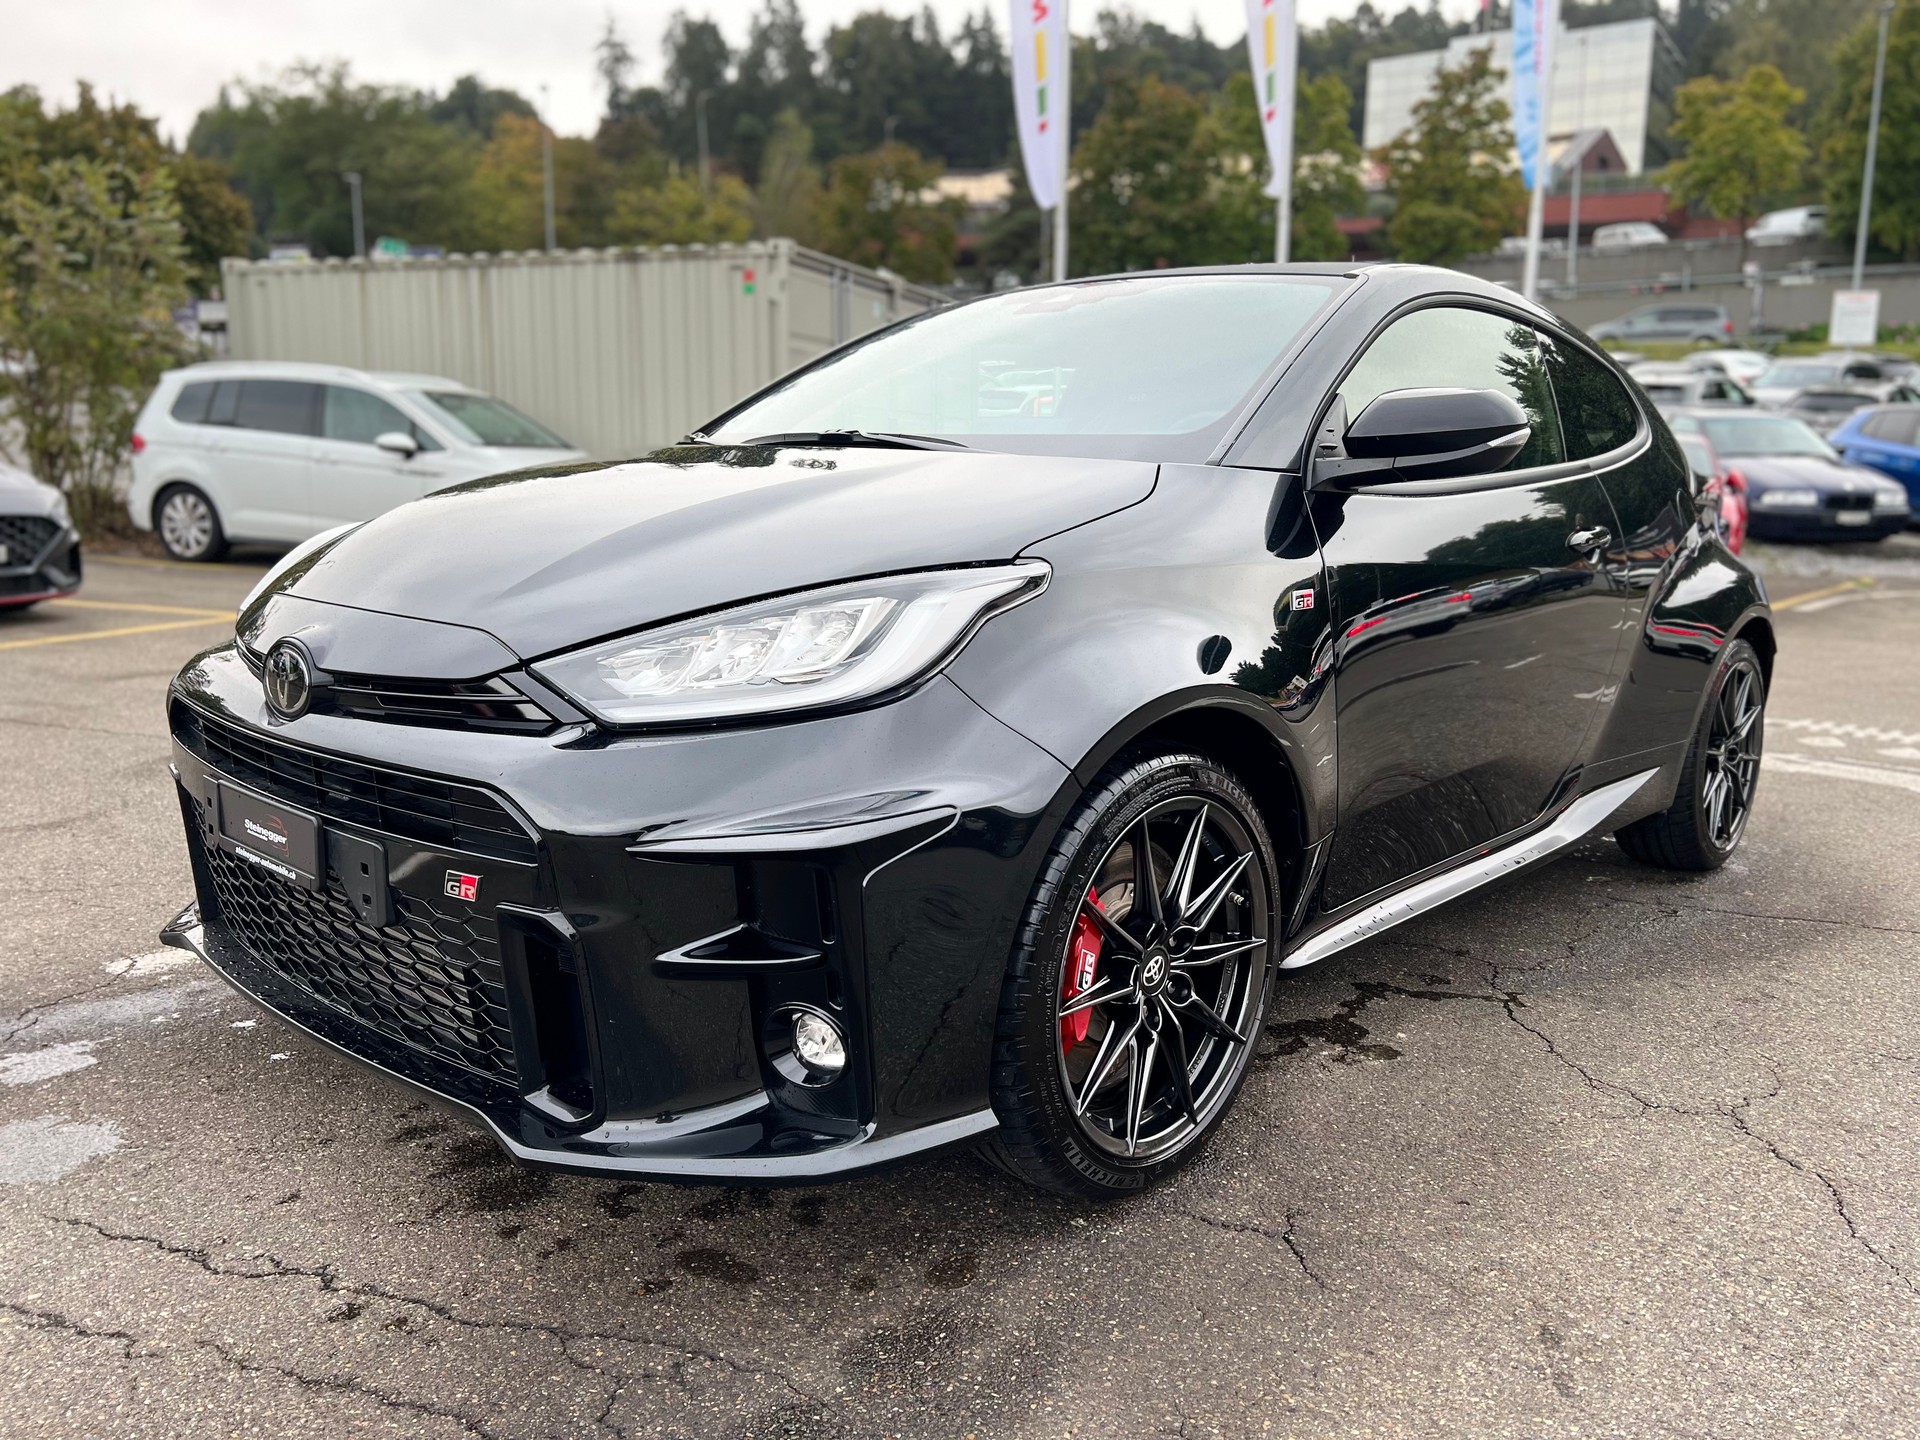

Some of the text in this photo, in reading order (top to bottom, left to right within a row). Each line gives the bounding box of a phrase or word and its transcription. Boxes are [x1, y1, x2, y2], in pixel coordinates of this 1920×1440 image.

[244, 818, 287, 844] Steinegger
[235, 846, 296, 880] steinegger-automobile.ch
[445, 878, 477, 901] GR
[1082, 953, 1095, 990] GR
[1061, 1138, 1127, 1187] MICHELIN
